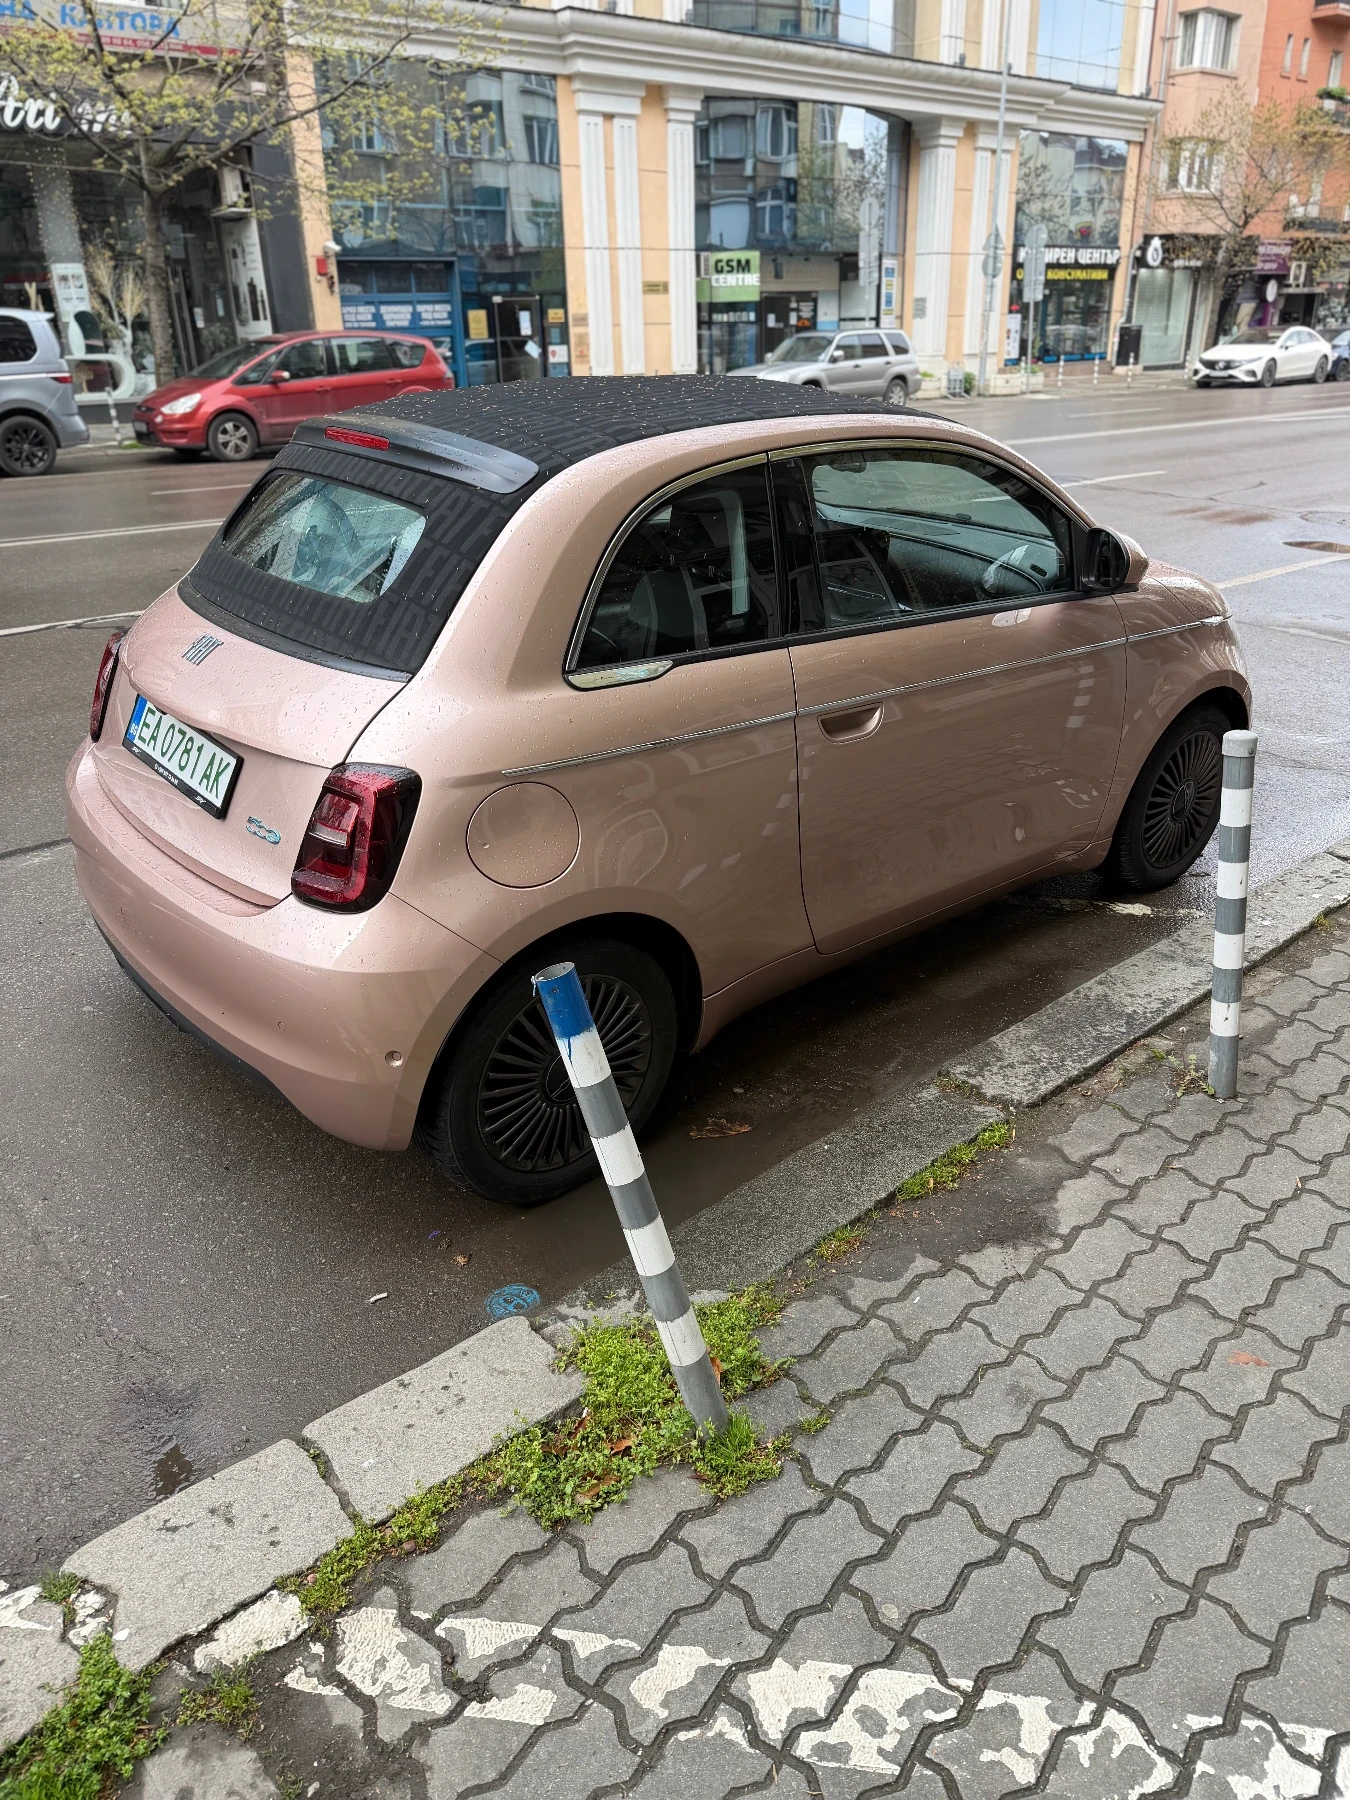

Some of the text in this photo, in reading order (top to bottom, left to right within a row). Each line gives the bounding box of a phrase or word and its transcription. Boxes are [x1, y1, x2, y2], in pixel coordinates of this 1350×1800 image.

[1077, 247, 1120, 265] ЦЕНТЪР
[714, 258, 751, 274] GSM
[711, 273, 761, 287] CENTRE
[137, 706, 163, 752] EA
[160, 722, 205, 780] 0781
[198, 751, 231, 800] AK
